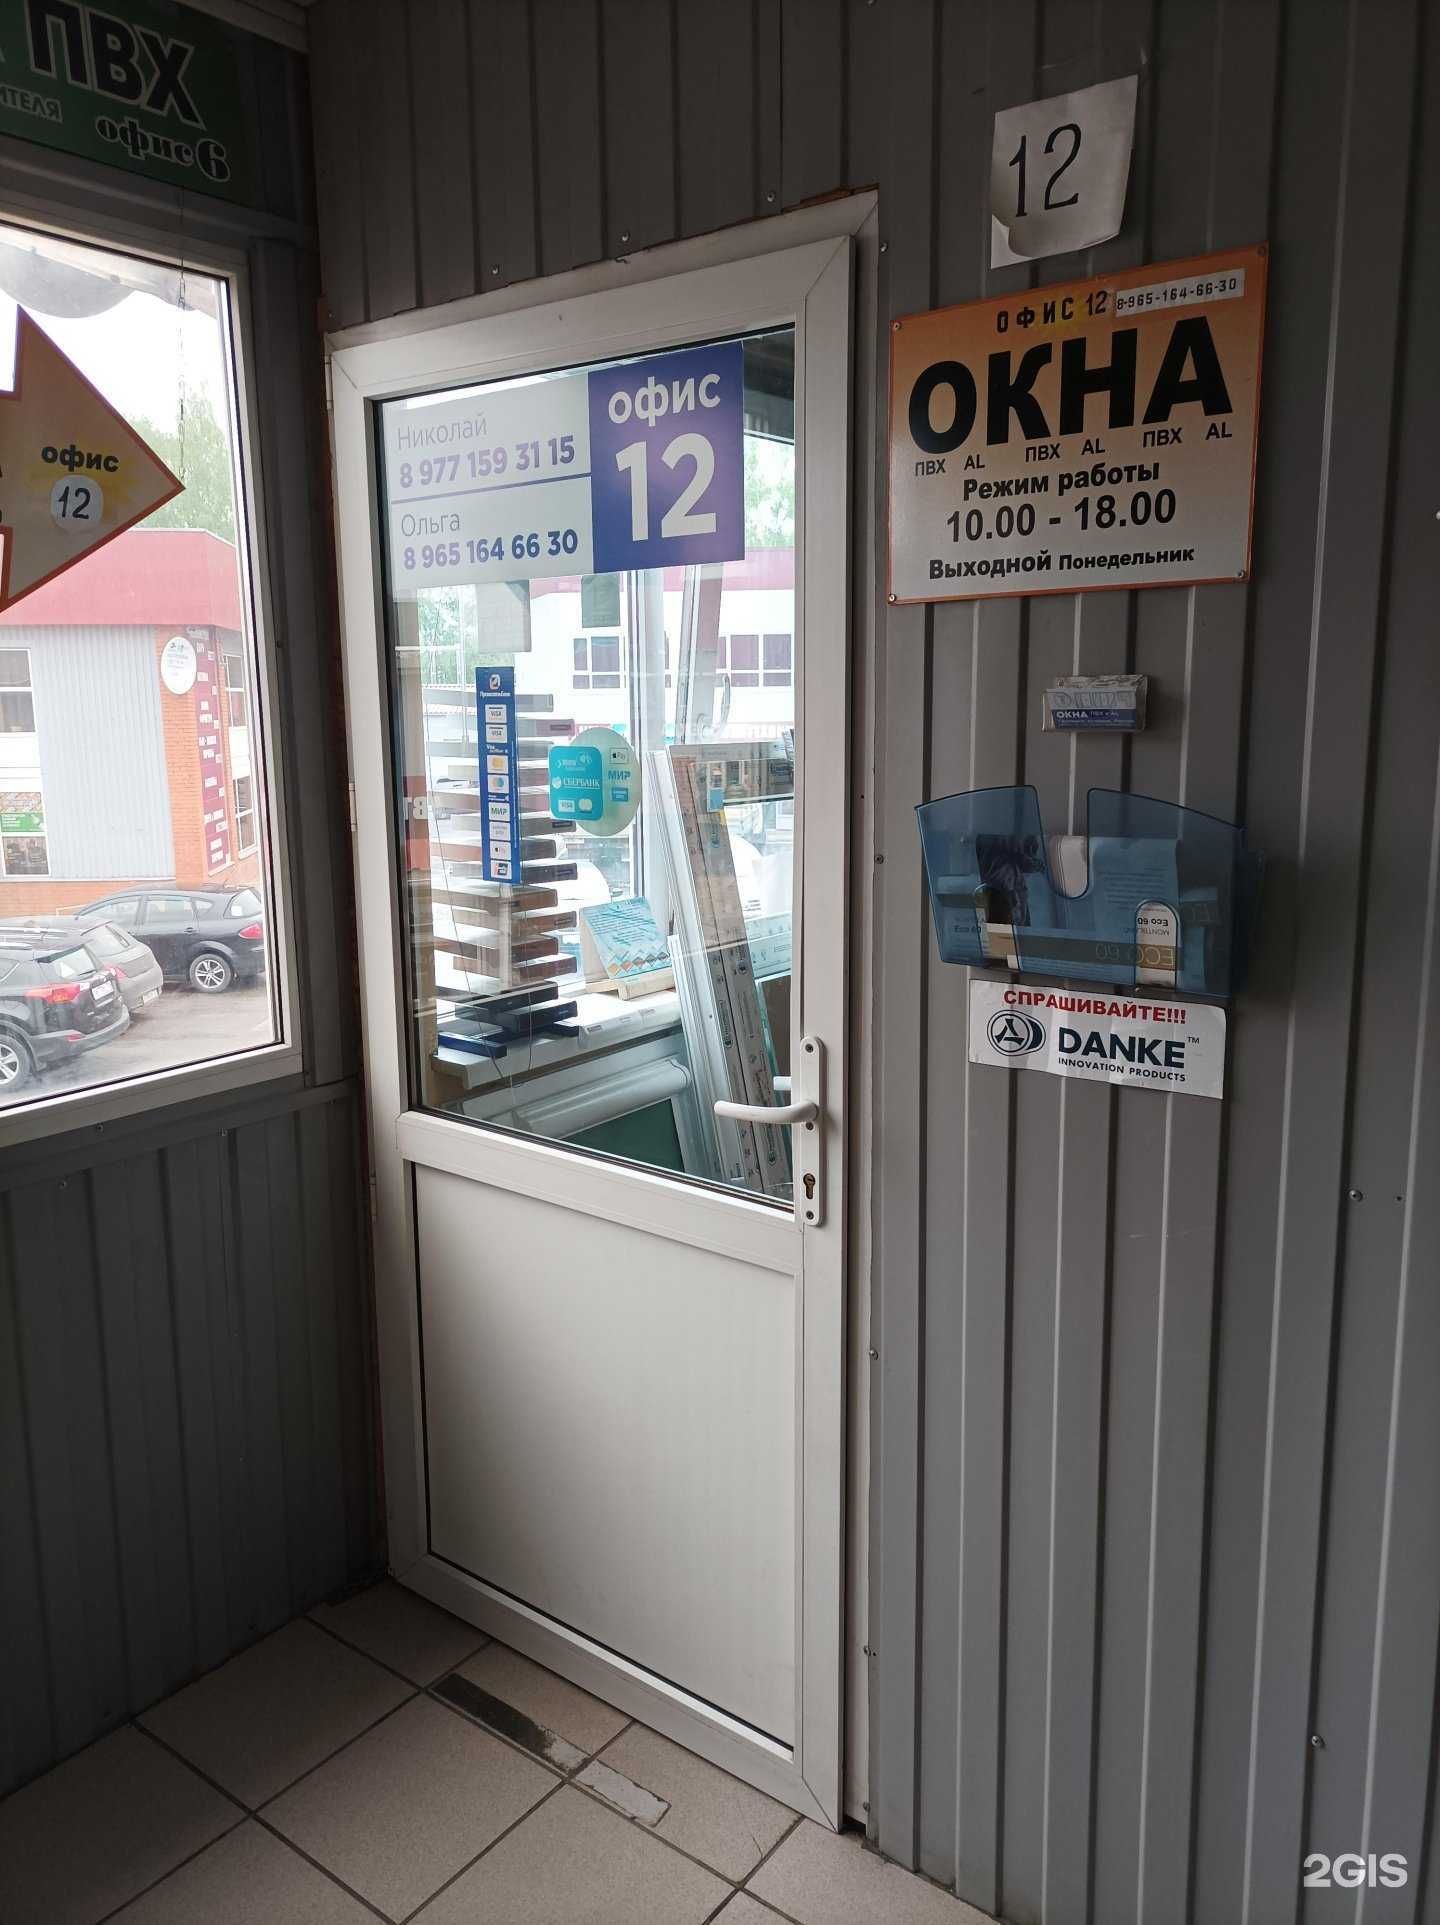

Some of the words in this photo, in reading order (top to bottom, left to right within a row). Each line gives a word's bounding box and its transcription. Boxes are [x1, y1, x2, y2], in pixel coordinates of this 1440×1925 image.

[25, 0, 207, 131] ПВХ
[96, 115, 194, 167] офис
[195, 138, 231, 183] 6
[1009, 123, 1082, 217] 12
[996, 297, 1074, 333] ОФИС
[1085, 290, 1108, 316] 12
[1116, 277, 1237, 311] 8-965-164-66-30
[607, 372, 721, 427] офис
[908, 315, 1233, 454] ОКНА
[397, 411, 488, 451] Николай
[915, 459, 947, 477] ПВХ
[964, 455, 985, 471] AL
[1025, 443, 1061, 463] ПВХ
[1081, 438, 1106, 456] AL
[1143, 427, 1182, 449] ПВХ
[1205, 422, 1233, 441] AL
[41, 444, 120, 472] офис
[400, 462, 413, 488] 8
[420, 453, 461, 487] 977
[467, 446, 508, 480] 159
[516, 438, 541, 471] 31
[548, 434, 575, 467] 15
[615, 432, 717, 542] 12
[963, 471, 1049, 501] Режим
[1057, 461, 1160, 496] работы
[58, 485, 91, 520] 12
[947, 503, 1036, 543] 10.00
[1074, 488, 1177, 531] 18.00
[401, 510, 461, 538] Ольга
[403, 547, 417, 571] 8
[421, 542, 461, 569] 965
[466, 538, 505, 564] 164
[511, 533, 541, 560] 66
[547, 528, 578, 556] 30
[929, 550, 1052, 580] Выходной
[1058, 546, 1195, 572] Понедельник
[1056, 711, 1088, 719] ОКНА
[608, 770, 631, 781] МИР
[1151, 918, 1169, 927] Eco
[1003, 990, 1187, 1024] СПРАШИВАЙТЕ!!!
[1058, 1026, 1186, 1069] DANKE
[1058, 1057, 1125, 1074] INNOVATION
[1129, 1067, 1186, 1082] PRODUCTS
